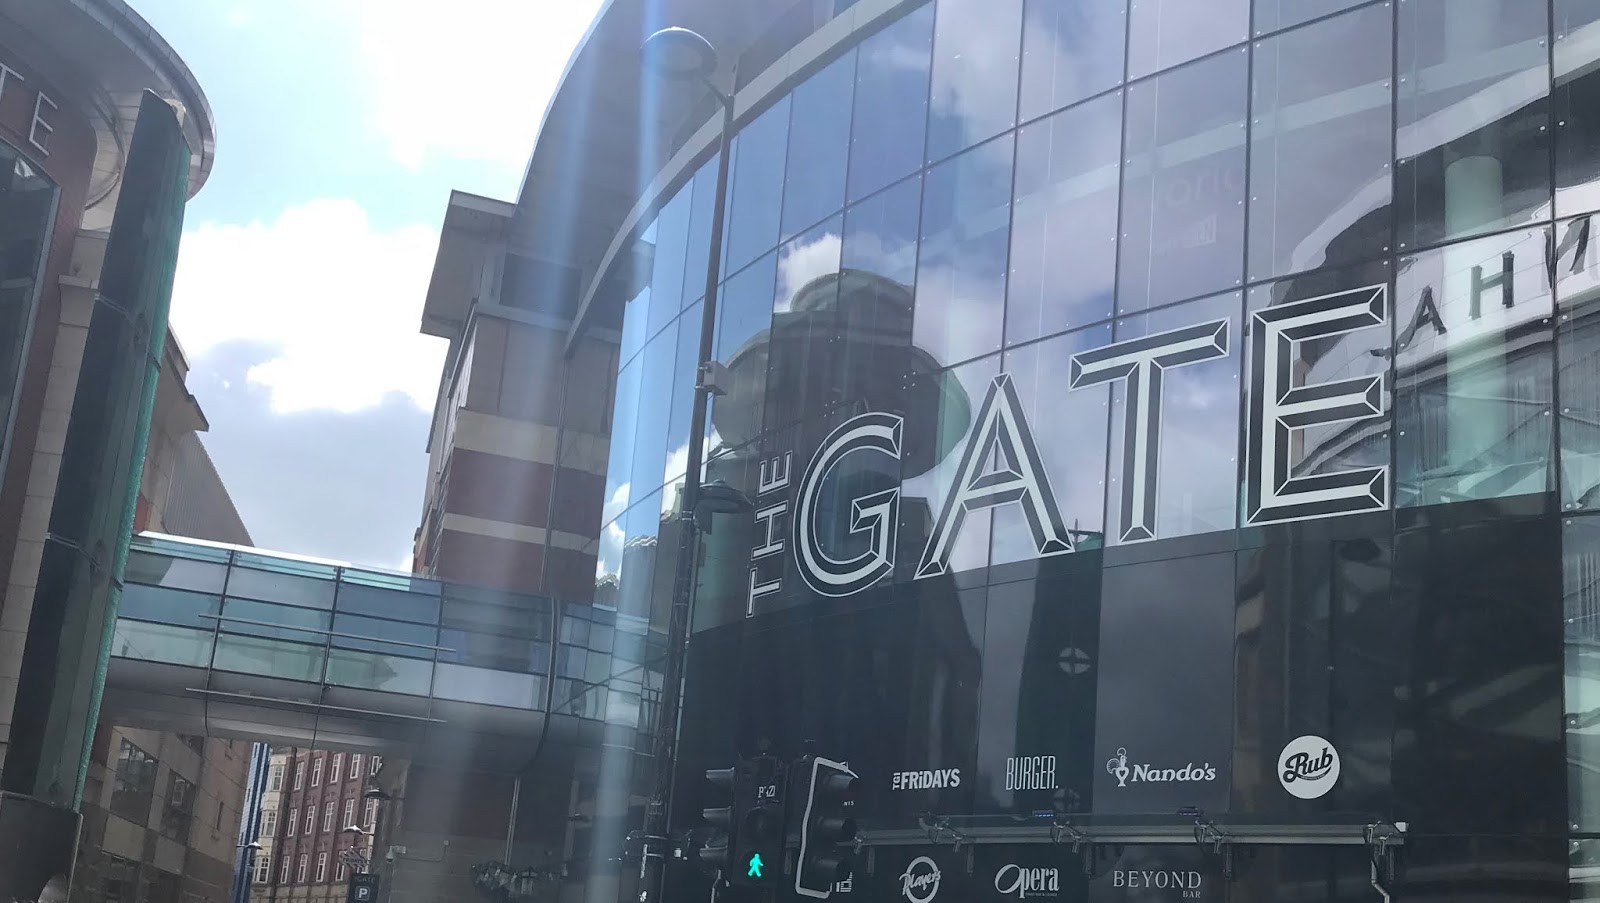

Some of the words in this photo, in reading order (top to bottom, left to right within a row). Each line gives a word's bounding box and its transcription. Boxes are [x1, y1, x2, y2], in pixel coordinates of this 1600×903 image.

[793, 284, 1389, 598] GATE
[746, 450, 792, 618] THE
[1131, 762, 1216, 782] Nando's
[1283, 747, 1333, 783] Rub
[892, 772, 900, 790] TGI
[899, 871, 941, 895] Players
[995, 864, 1060, 898] Opera
[1113, 870, 1202, 889] BEYOND
[358, 888, 368, 898] P
[1182, 890, 1201, 898] BAR
